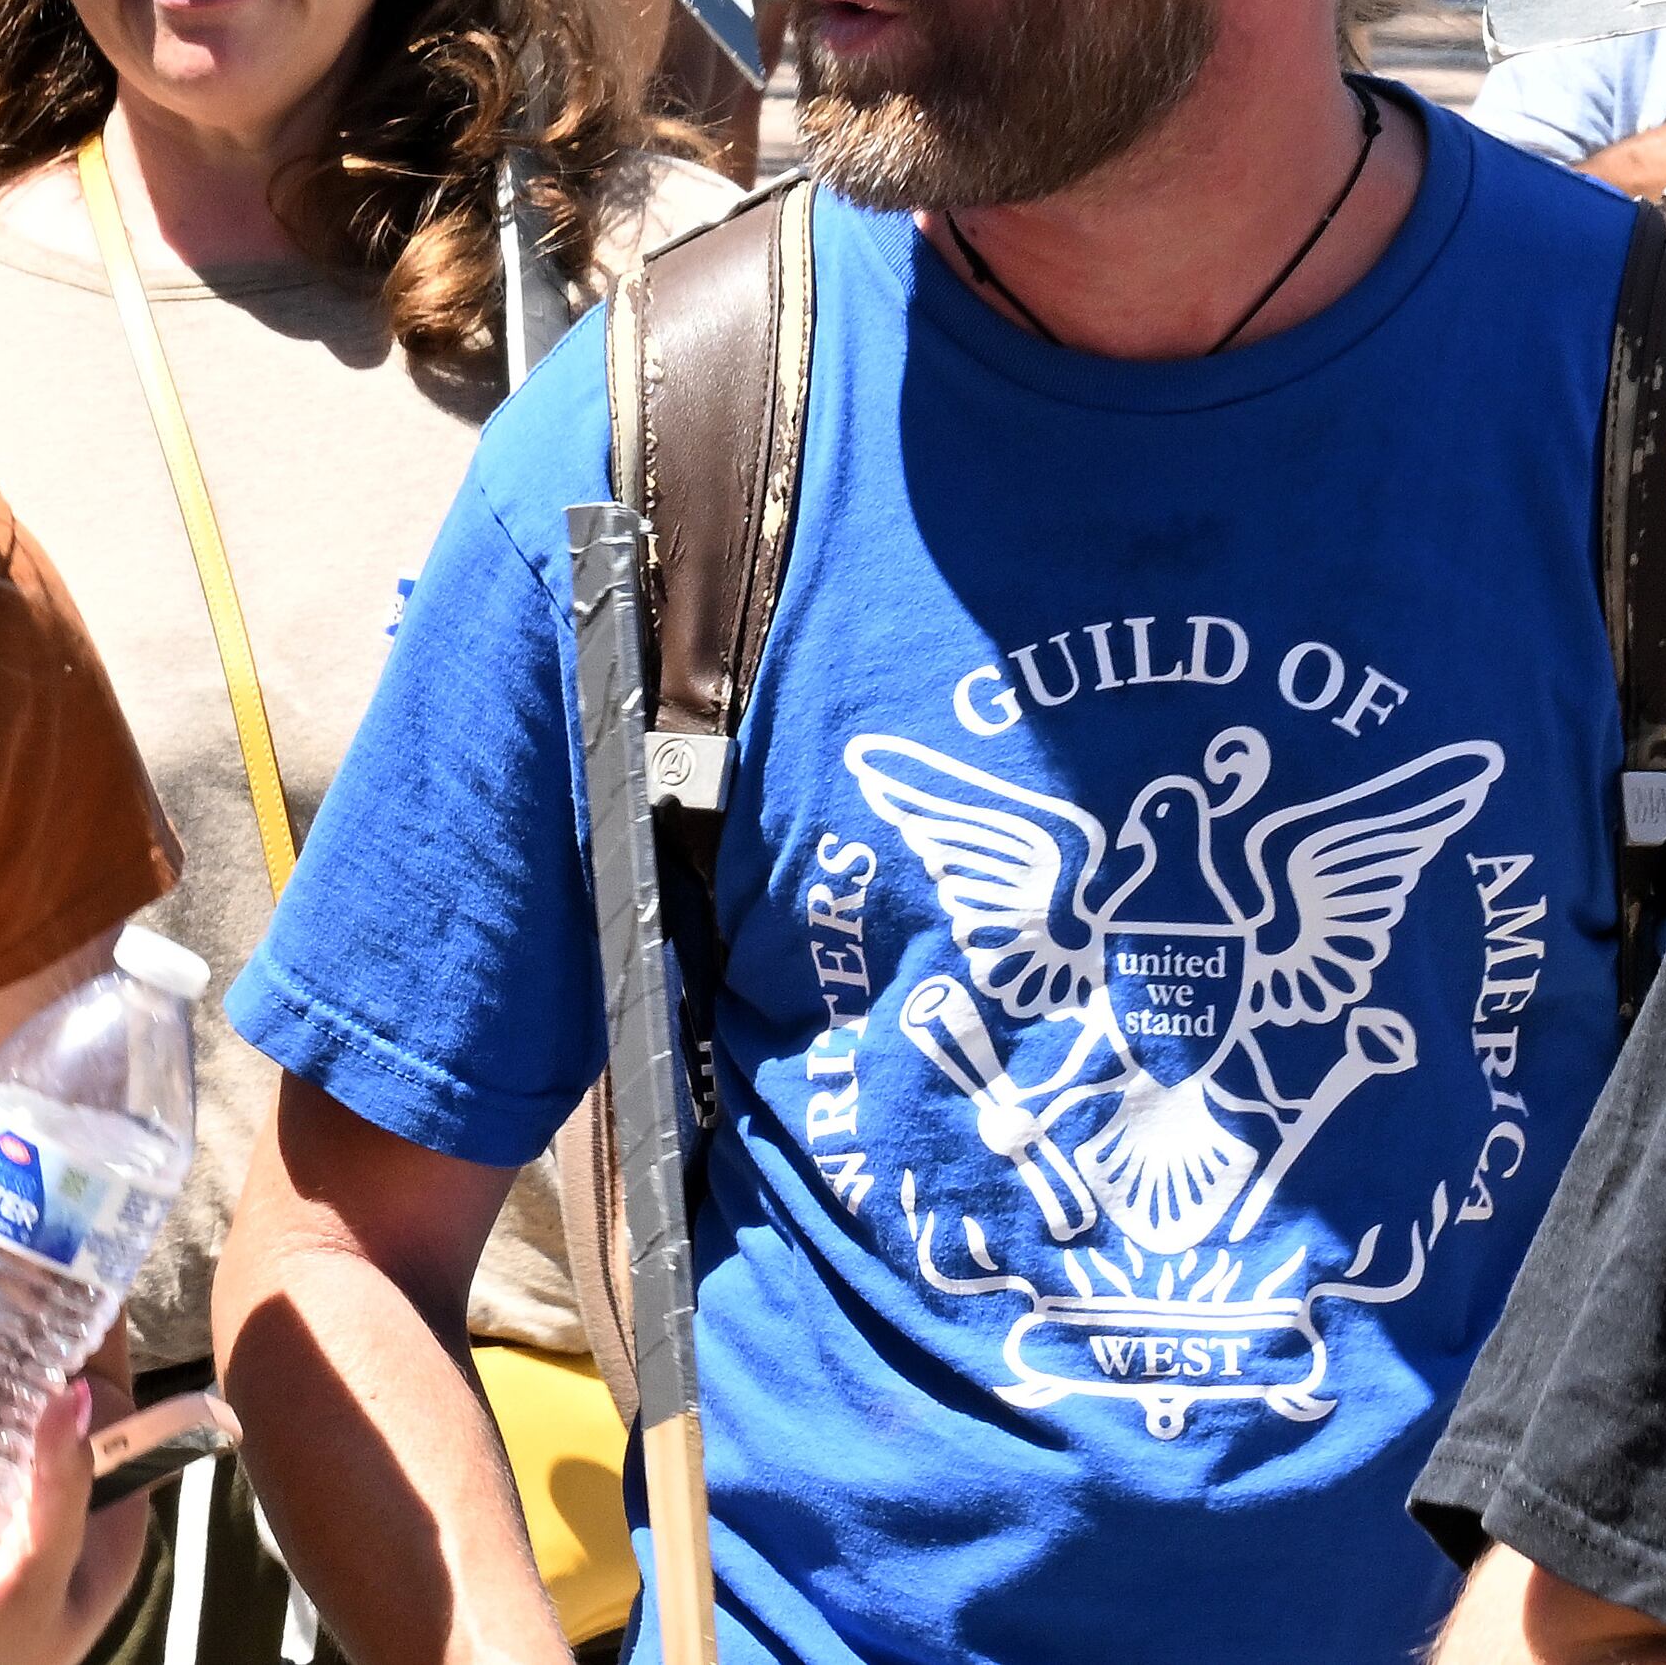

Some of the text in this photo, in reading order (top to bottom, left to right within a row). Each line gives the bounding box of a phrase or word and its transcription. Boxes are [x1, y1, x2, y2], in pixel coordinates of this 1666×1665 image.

[953, 613, 1412, 738] GUILD OF
[1116, 944, 1227, 979] united
[1145, 983, 1195, 1007] we
[805, 824, 878, 1216] WRITERS
[1124, 1004, 1216, 1037] stand
[1465, 850, 1551, 1226] AMERICA
[1088, 1334, 1251, 1379] WEST
